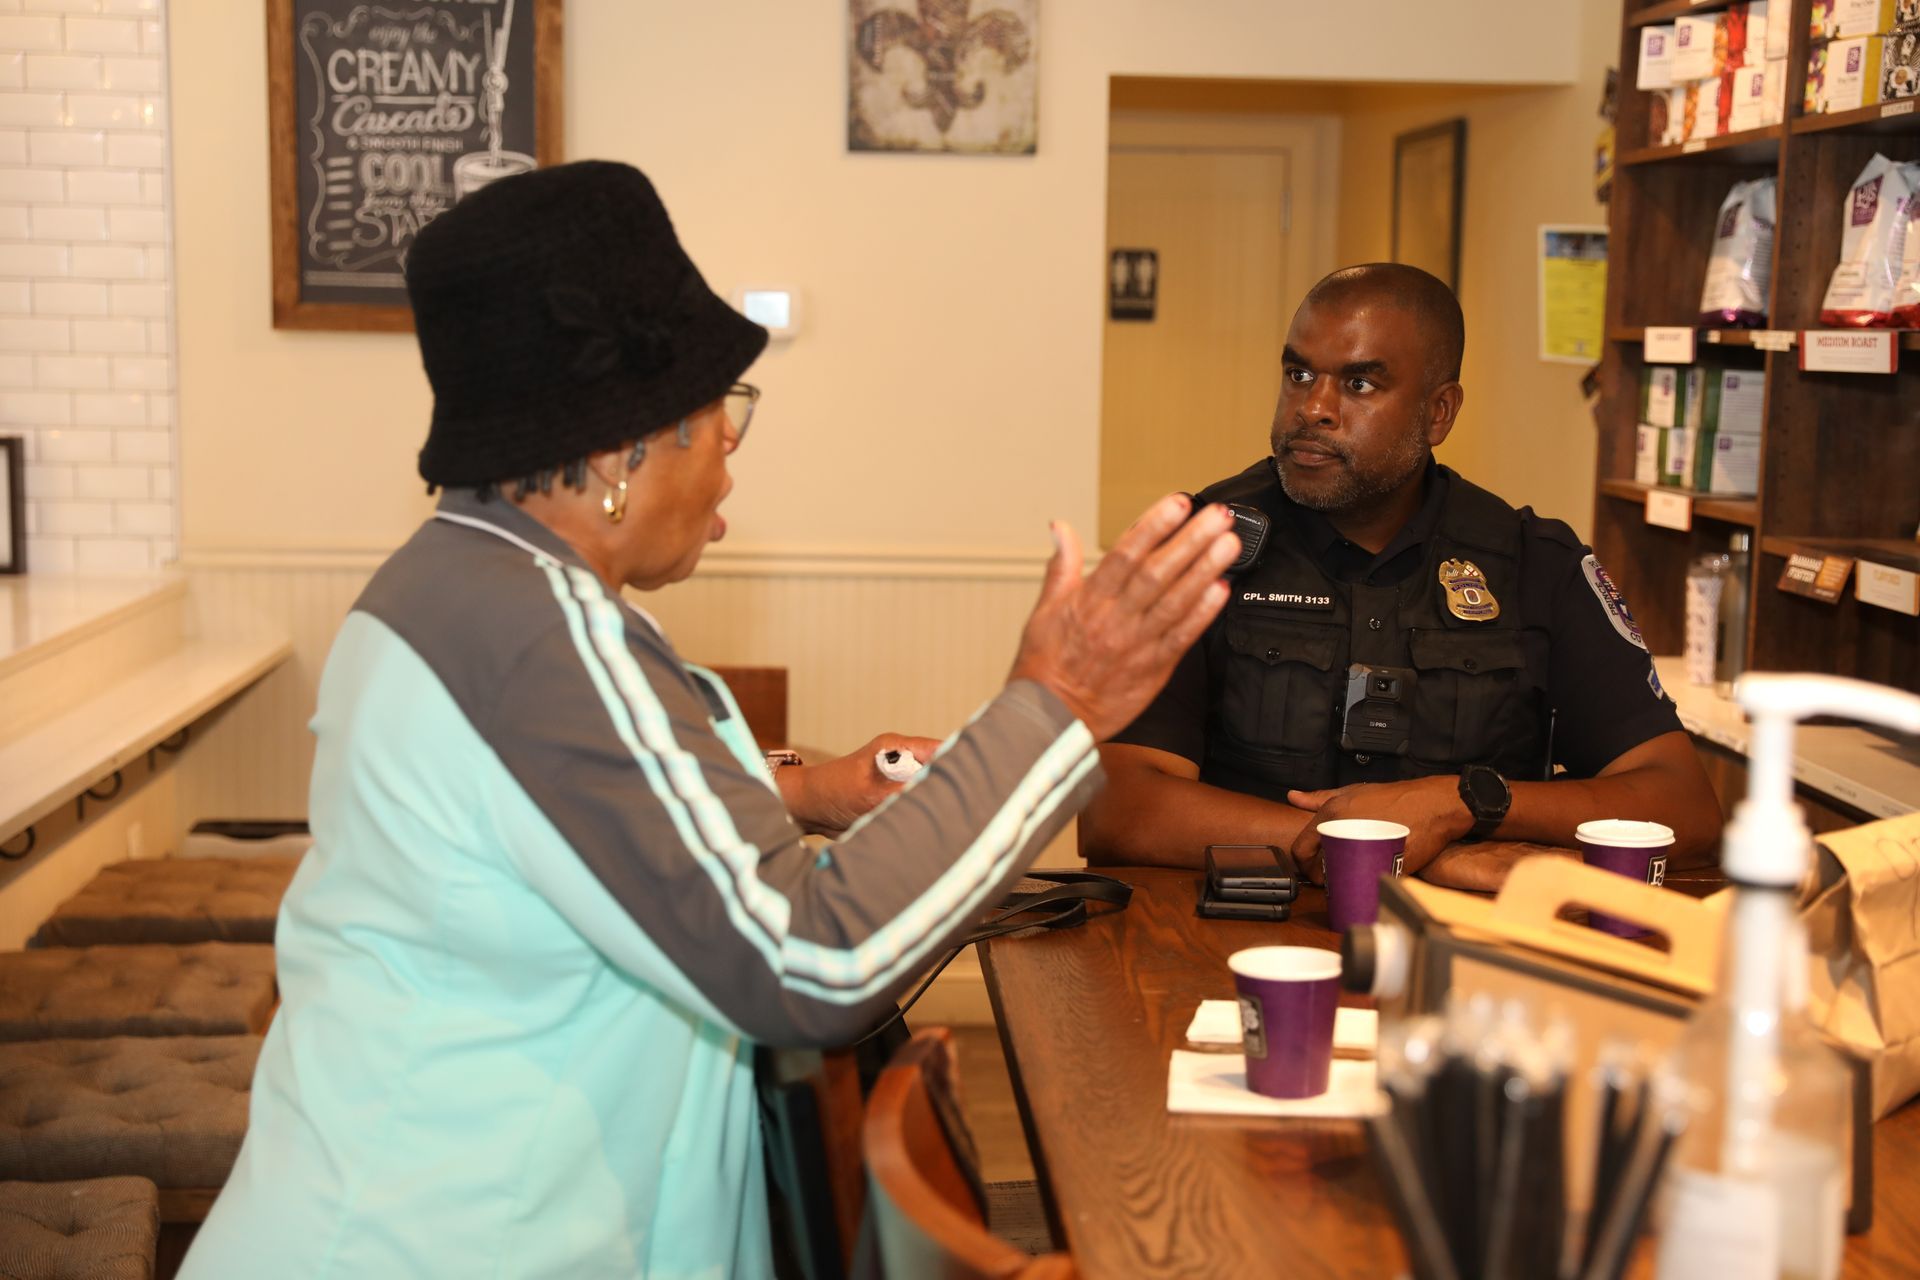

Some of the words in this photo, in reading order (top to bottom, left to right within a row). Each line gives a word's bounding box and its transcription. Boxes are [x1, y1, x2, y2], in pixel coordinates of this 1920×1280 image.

[328, 48, 481, 95] CREAMY
[360, 151, 454, 198] COOL
[1851, 336, 1878, 349] ROAST
[1236, 513, 1261, 525] MOTOROLA
[1243, 592, 1266, 601] CPL.
[1268, 593, 1303, 603] SMITH
[1304, 596, 1330, 605] 3133
[1595, 581, 1618, 616] PRINCE
